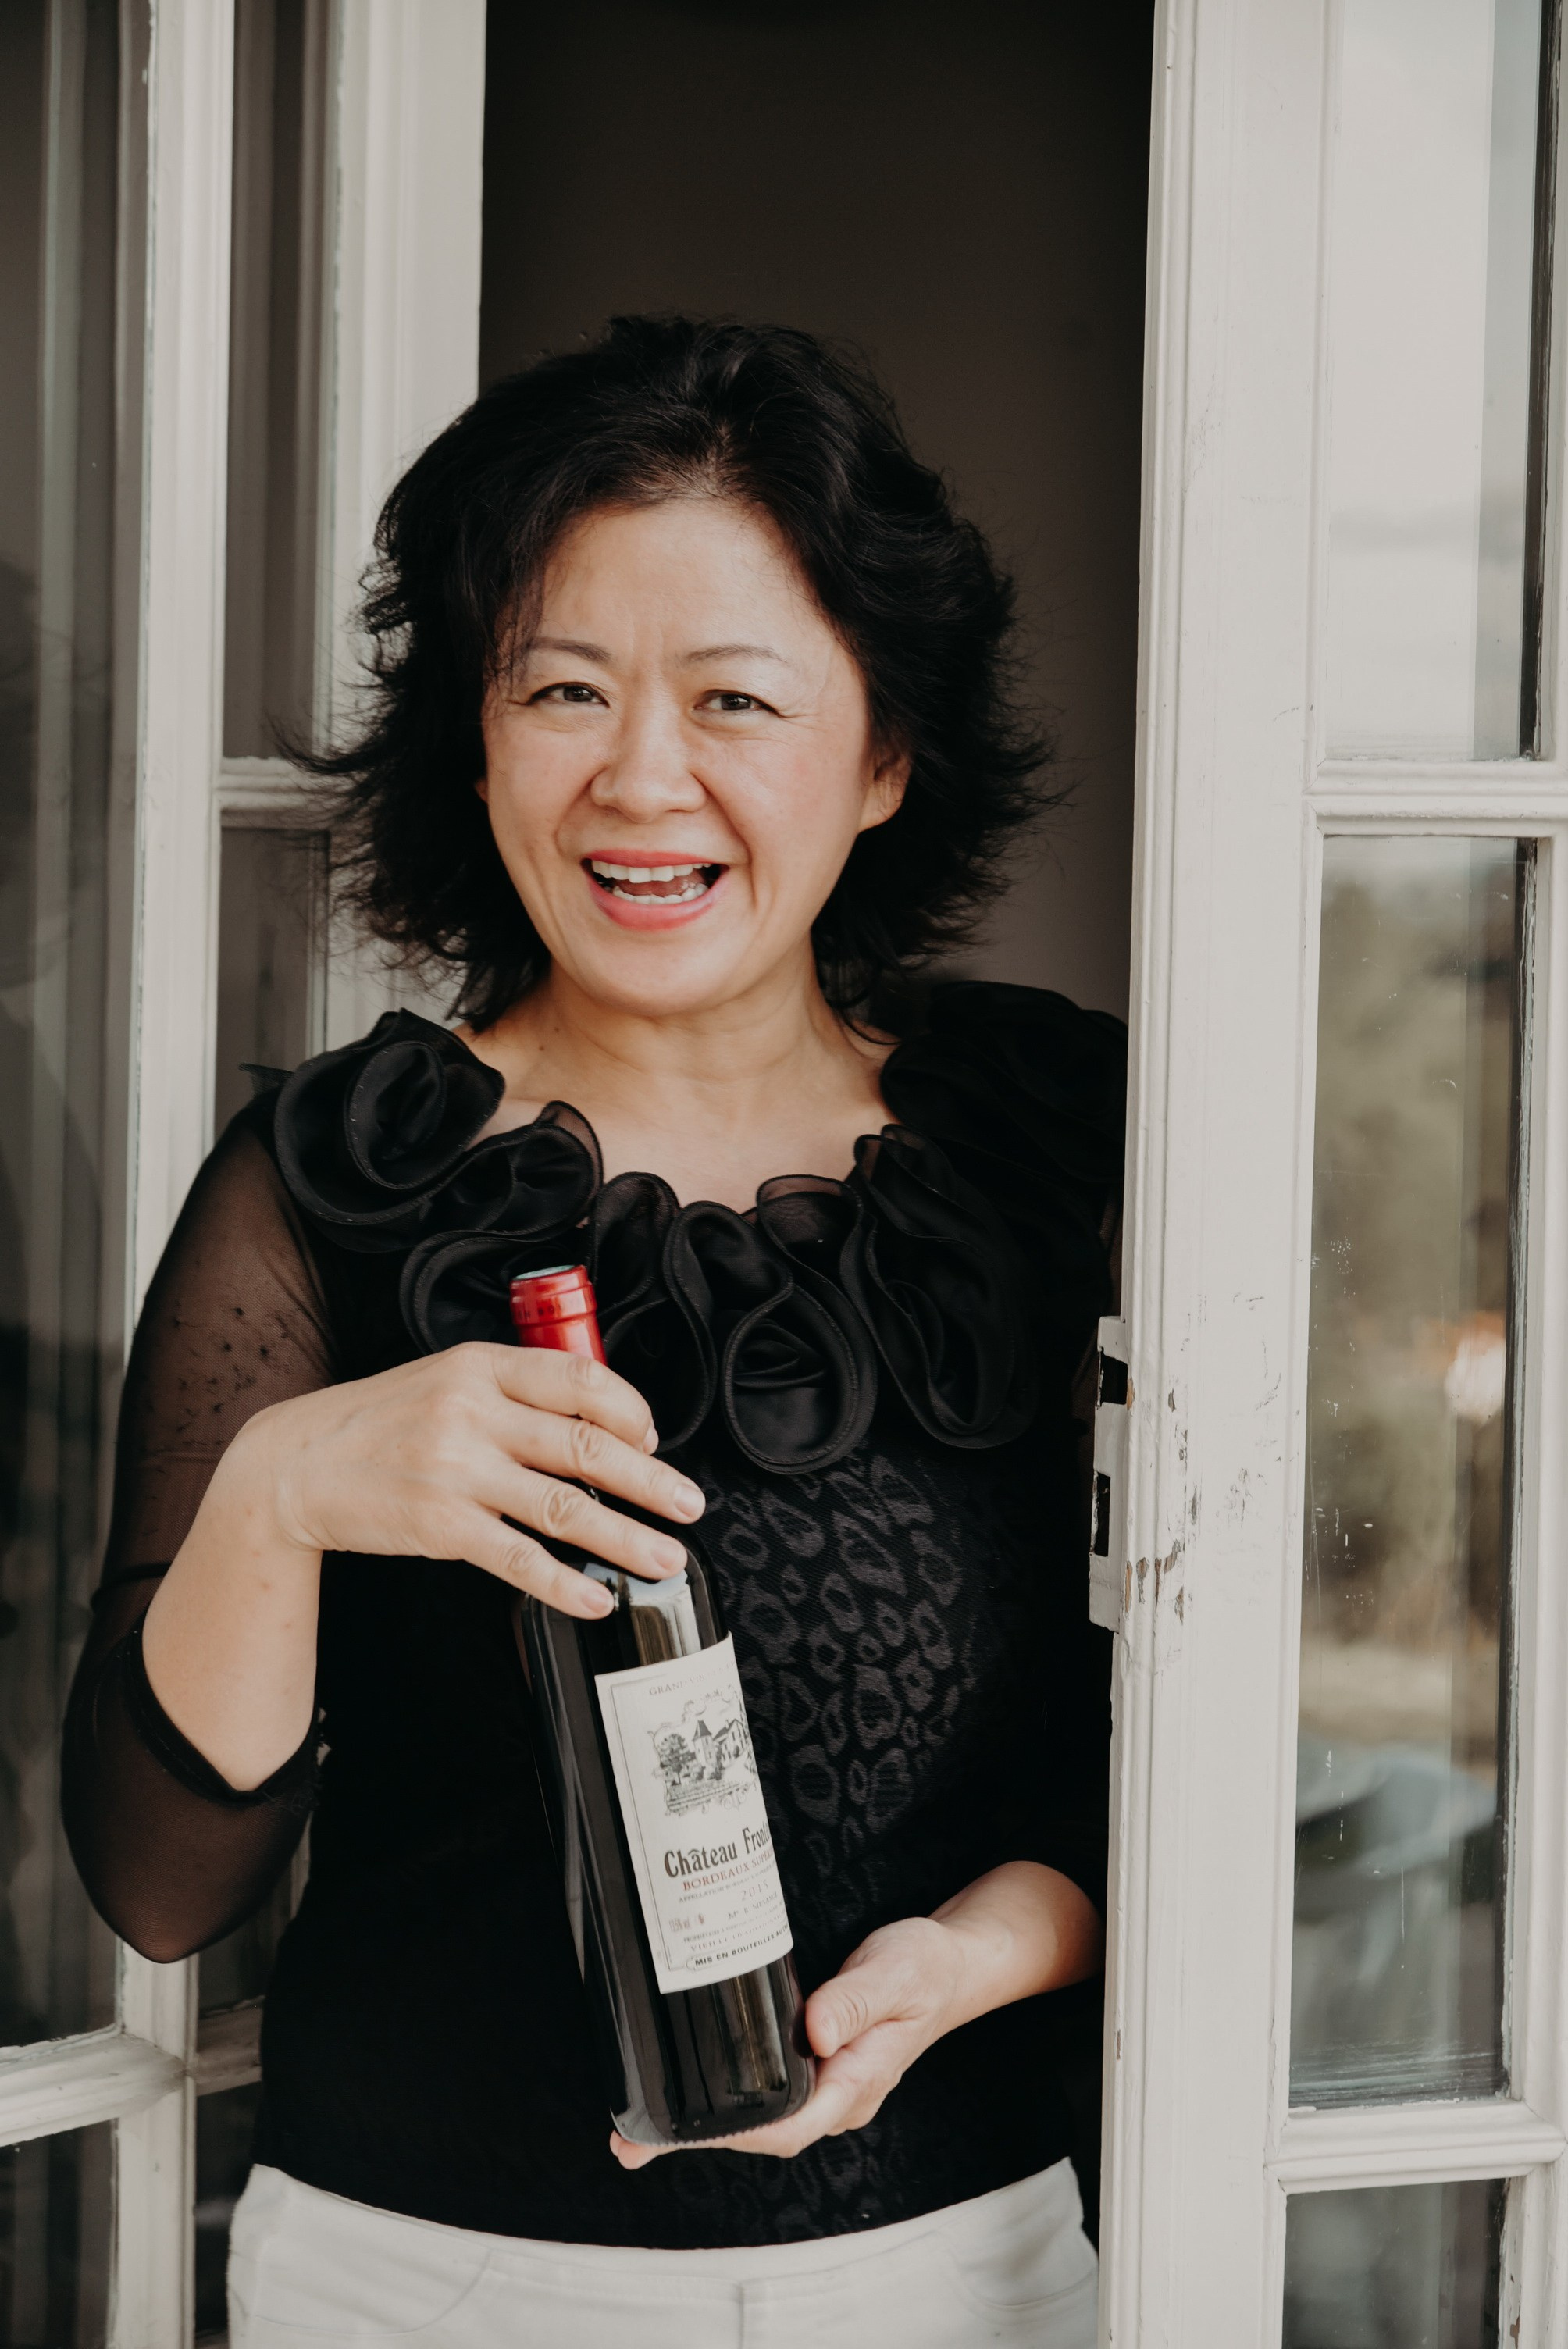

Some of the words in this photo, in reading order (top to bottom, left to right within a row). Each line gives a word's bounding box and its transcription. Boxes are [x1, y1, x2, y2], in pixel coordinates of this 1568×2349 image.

[664, 1841, 738, 1878] Château
[682, 1861, 750, 1891] BORDEAUX
[695, 1956, 713, 1966] MIS
[716, 1952, 729, 1962] EN
